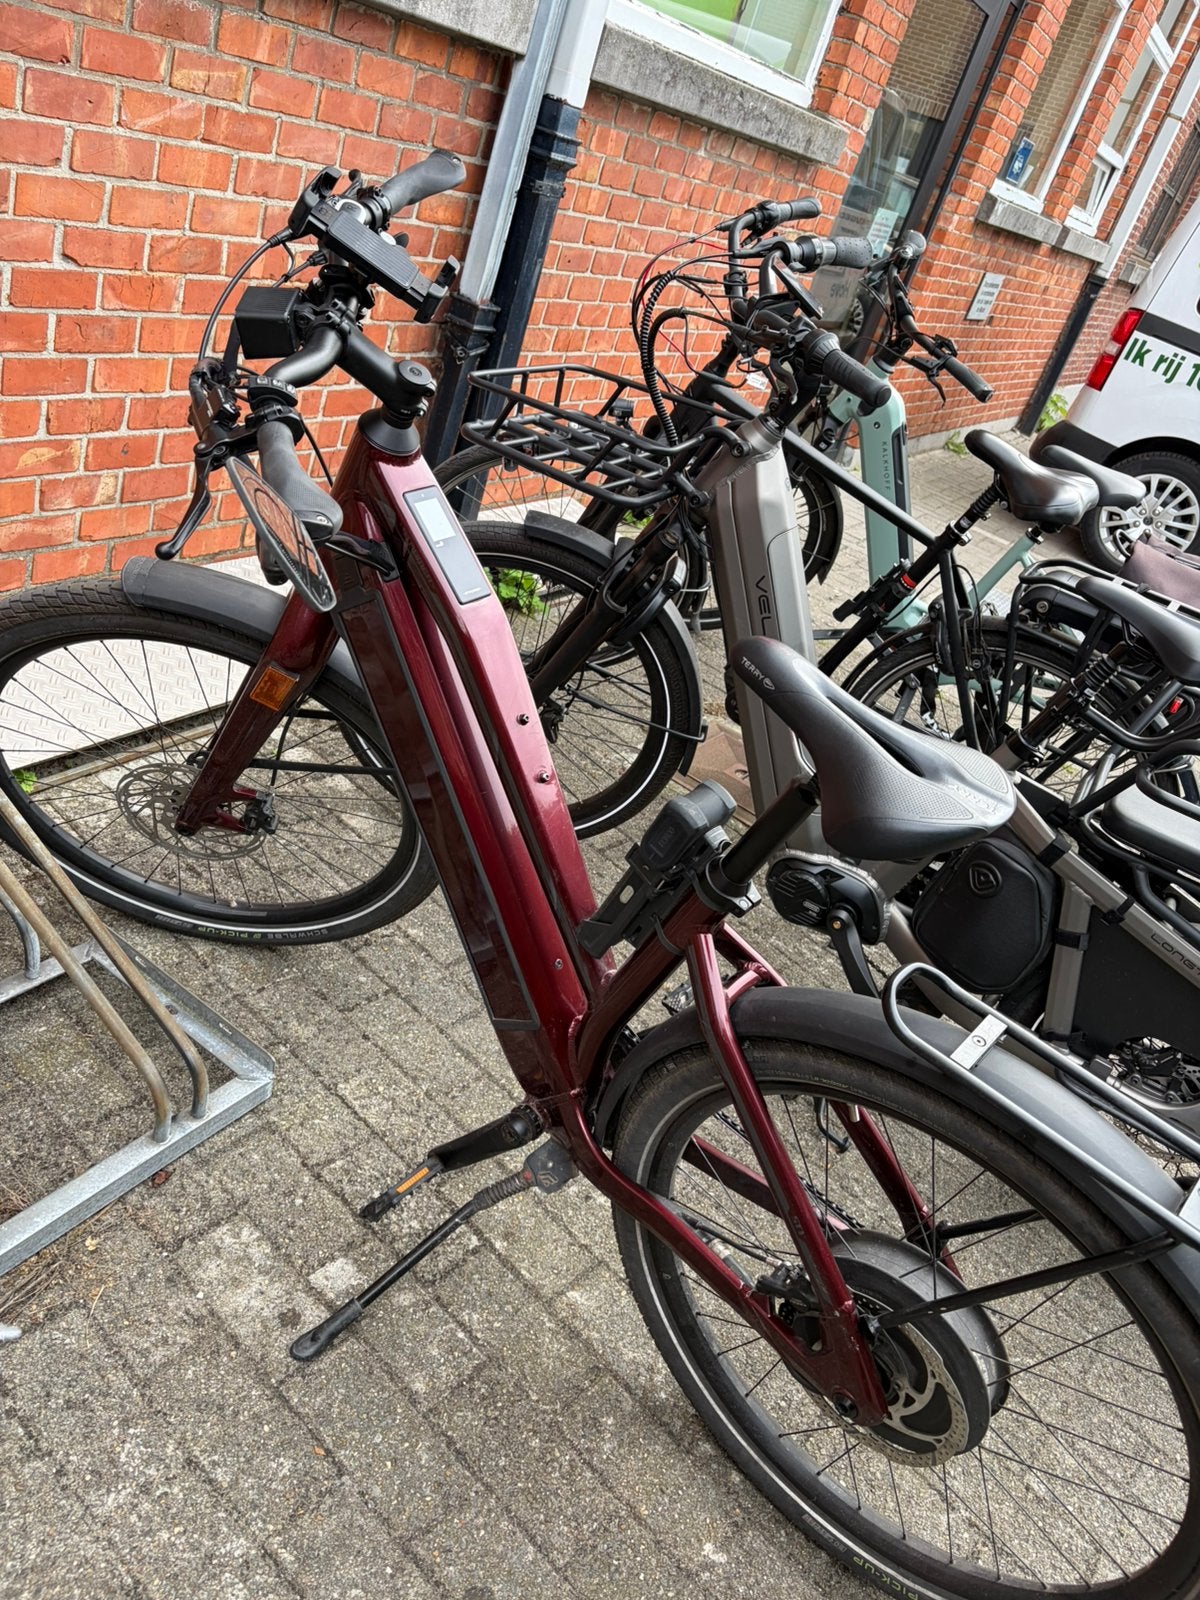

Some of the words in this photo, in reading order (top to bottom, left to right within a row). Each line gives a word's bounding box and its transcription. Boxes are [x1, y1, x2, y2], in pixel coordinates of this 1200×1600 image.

[1123, 337, 1152, 368] Ik
[1152, 352, 1186, 384] rij
[1186, 362, 1200, 391] 1
[881, 440, 890, 490] KALKHOFF
[741, 656, 765, 680] TERRY
[267, 928, 328, 939] SCHWALBE
[853, 1556, 919, 1600] PICK-UP
